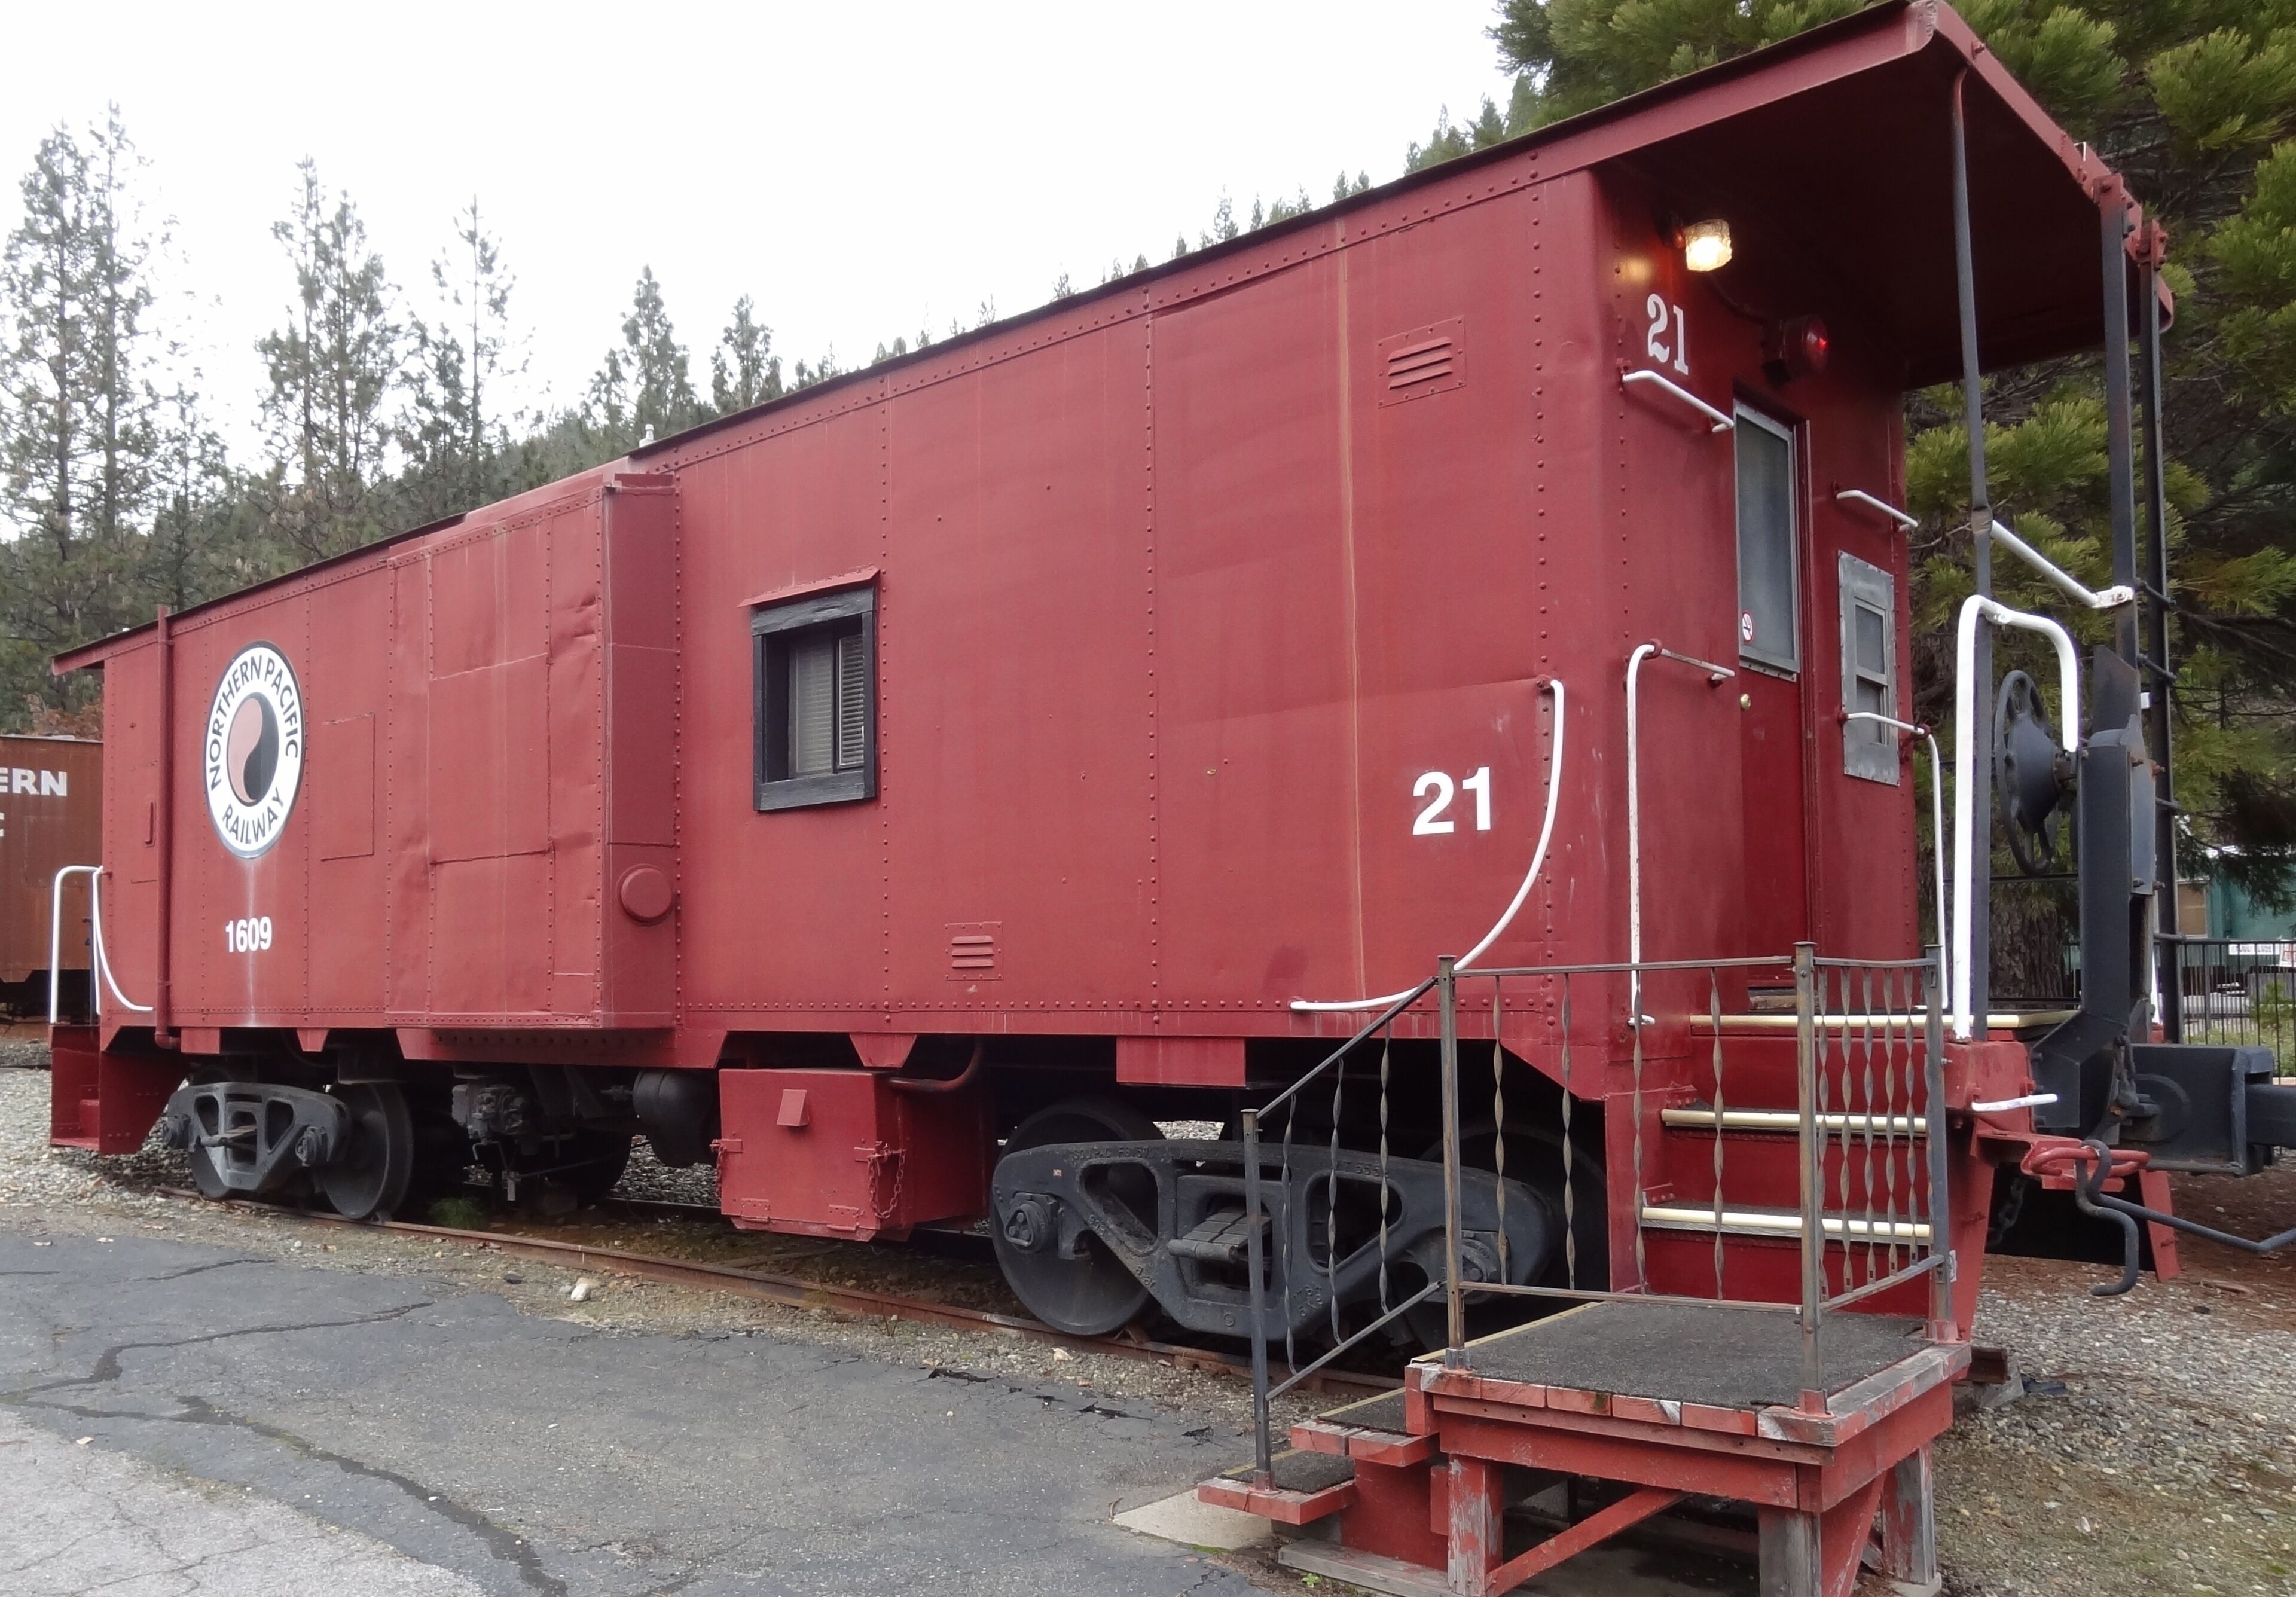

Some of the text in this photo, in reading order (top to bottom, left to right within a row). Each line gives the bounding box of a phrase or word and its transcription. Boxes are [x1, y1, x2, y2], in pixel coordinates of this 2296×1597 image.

[1647, 293, 1688, 375] 21
[209, 655, 298, 790] NORTHERN PACIFIC
[222, 786, 283, 844] RAILWAY
[1412, 766, 1491, 835] 21
[225, 916, 272, 952] 1609
